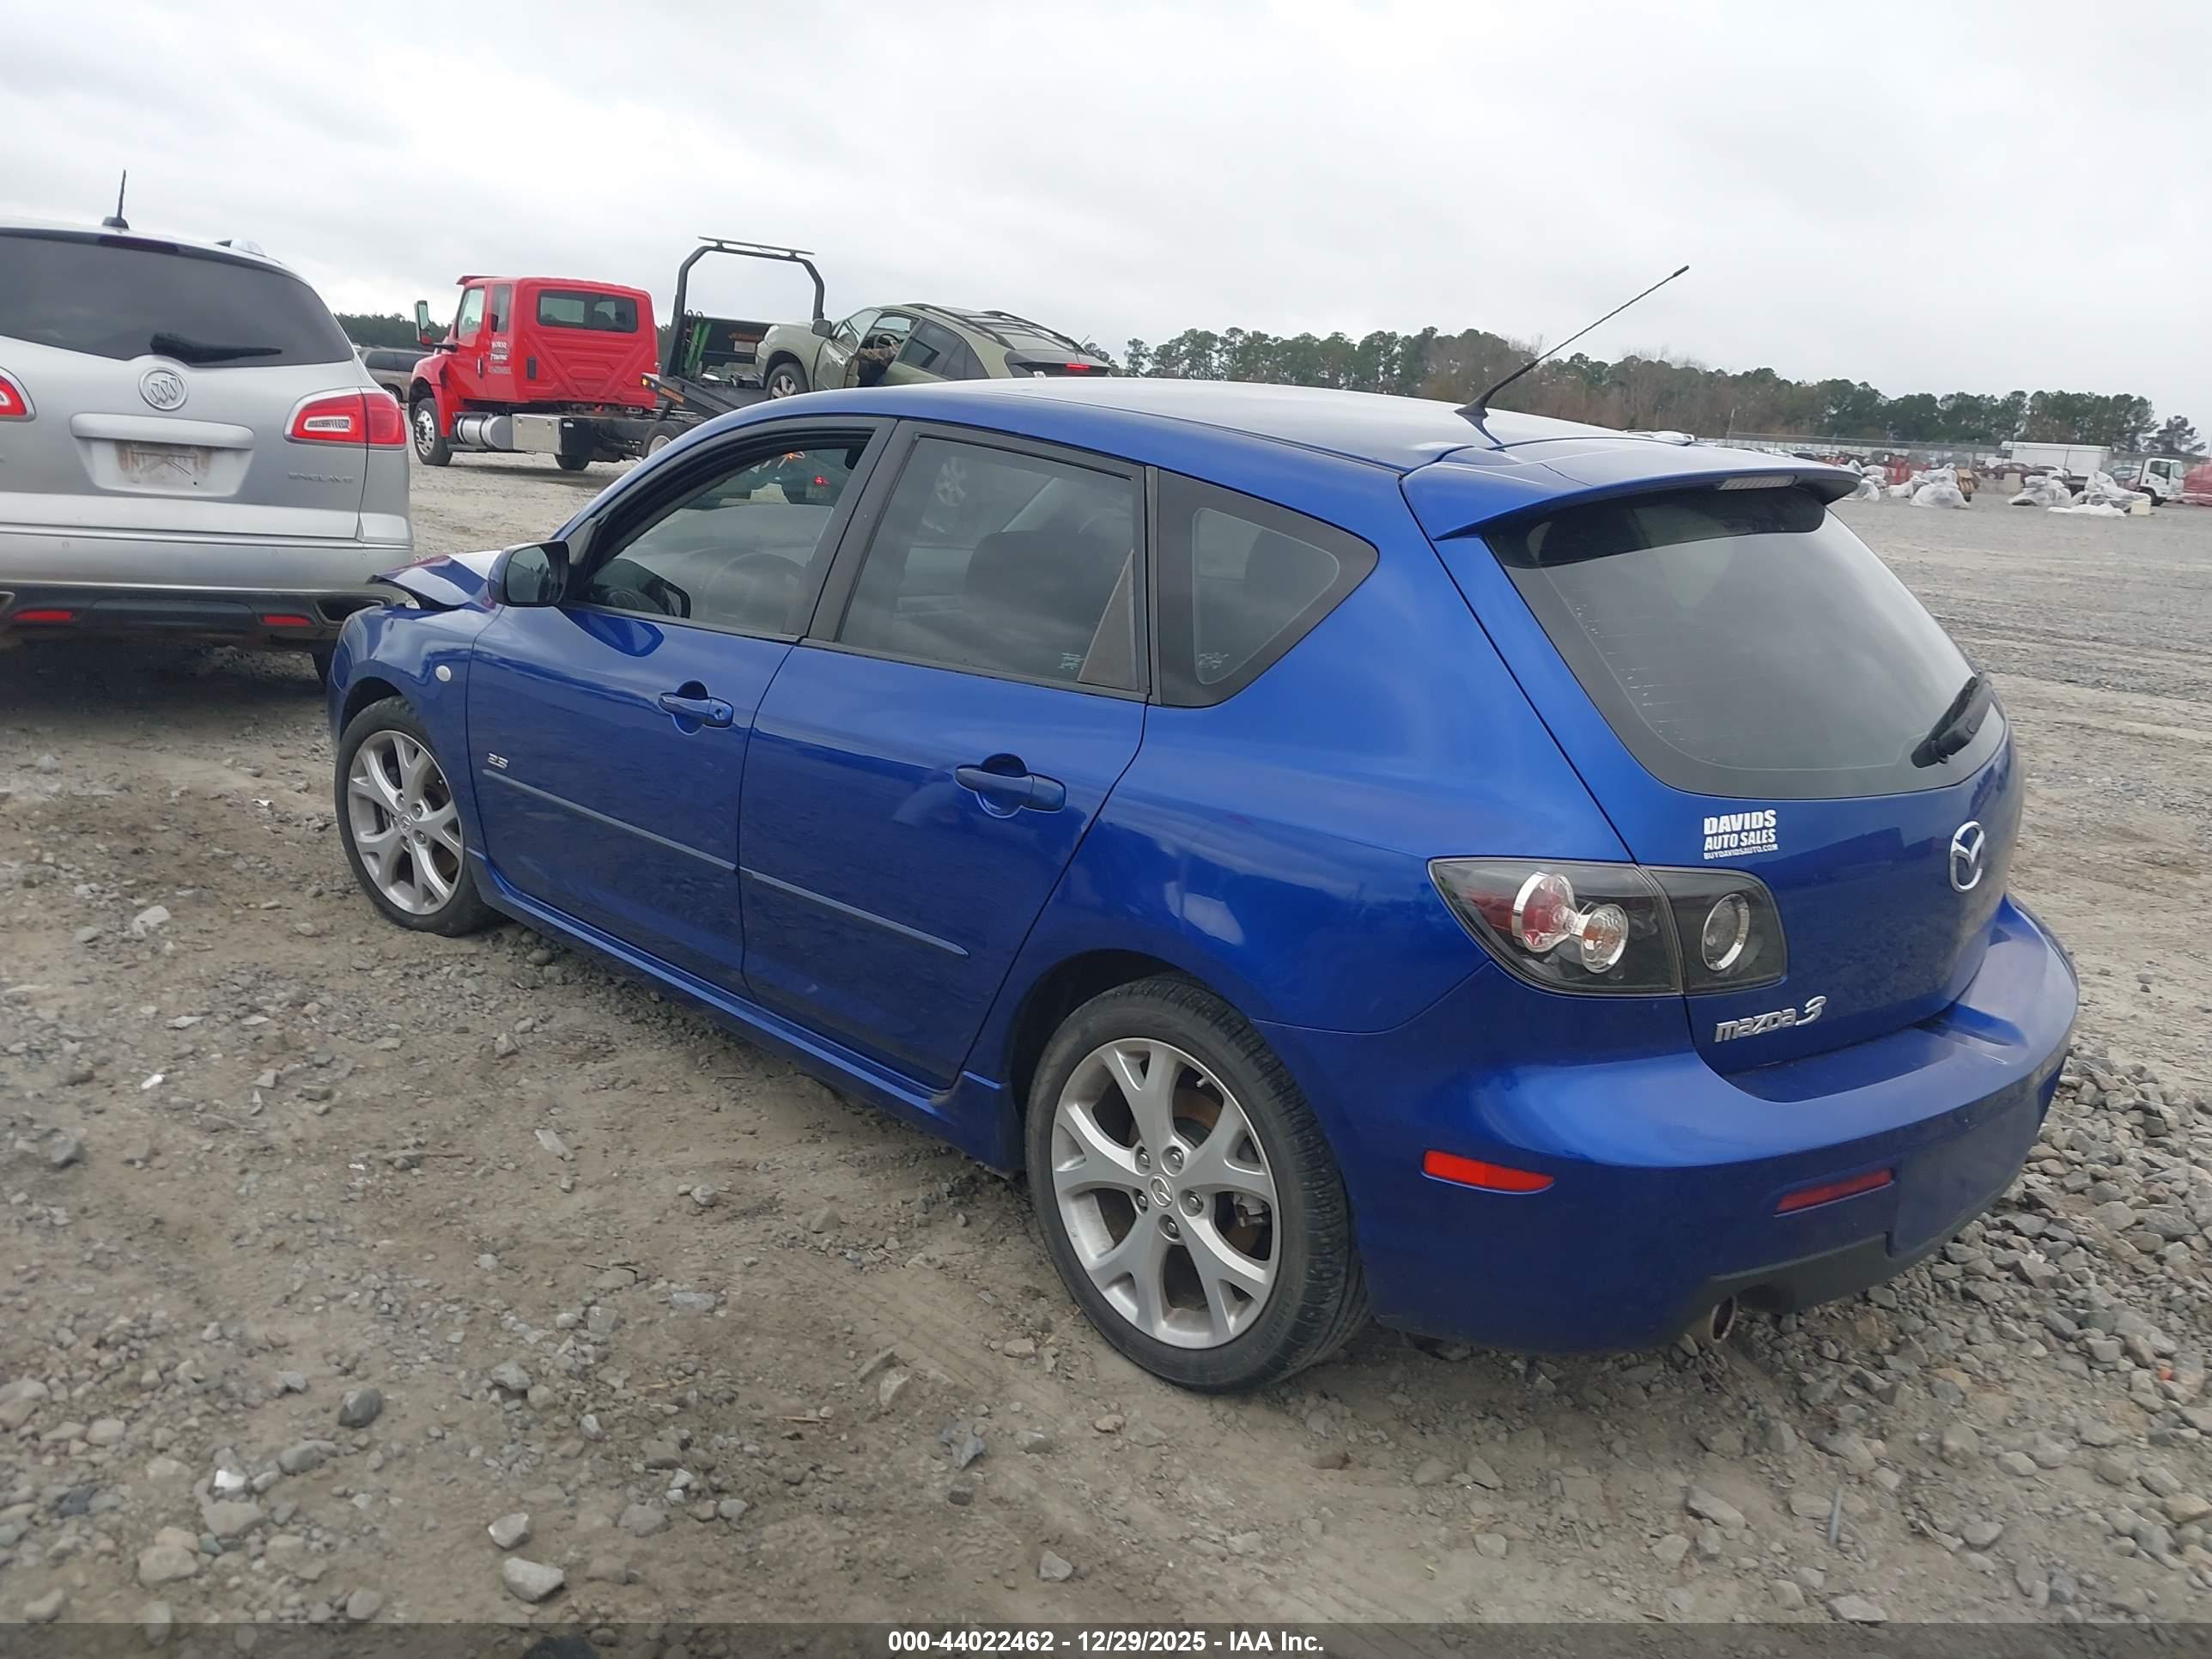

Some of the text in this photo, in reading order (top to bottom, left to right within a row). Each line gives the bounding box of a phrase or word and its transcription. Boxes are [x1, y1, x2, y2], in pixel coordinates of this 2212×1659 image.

[1704, 809, 1777, 836] DAVIDS
[1703, 843, 1779, 860] BUYDAVIDSAUTO.COM
[1704, 828, 1777, 852] AUTO SALES
